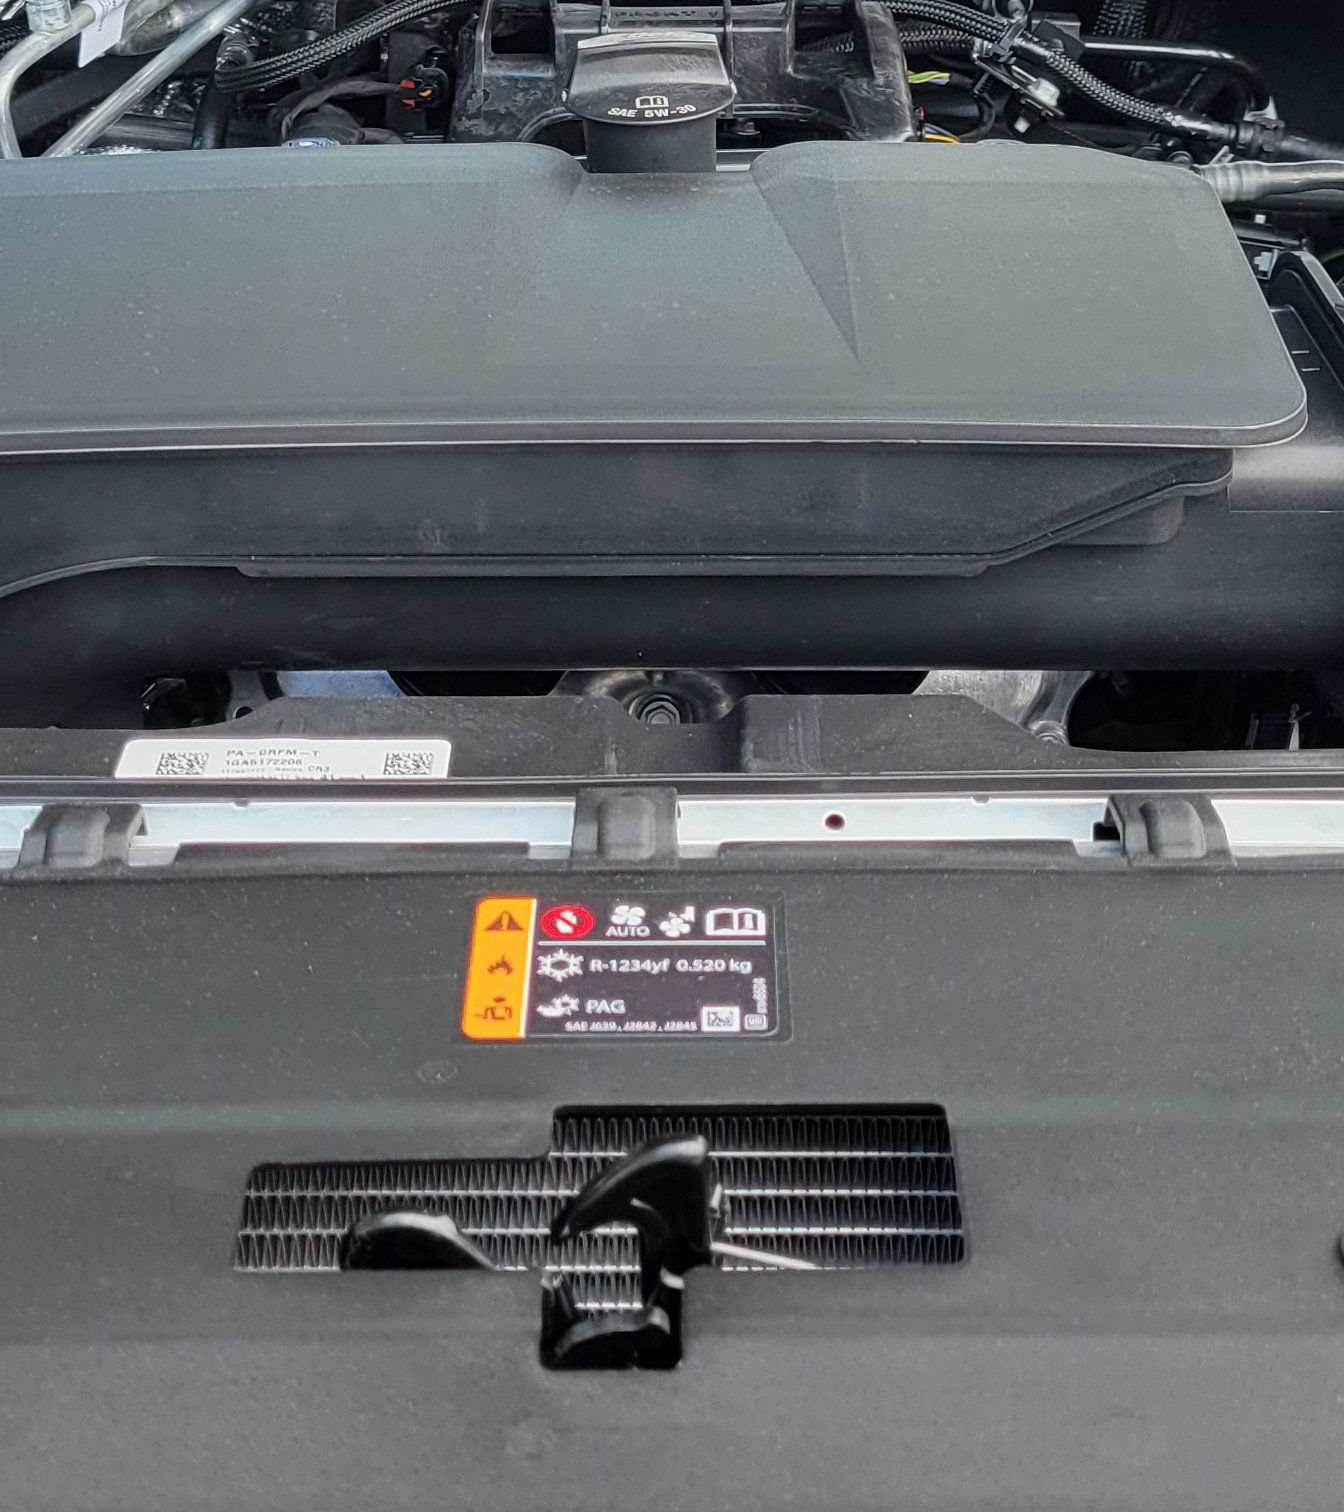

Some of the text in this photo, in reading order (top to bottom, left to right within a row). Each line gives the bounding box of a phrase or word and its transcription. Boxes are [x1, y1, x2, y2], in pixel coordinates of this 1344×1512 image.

[608, 104, 696, 118] SAE 5W-30
[607, 925, 651, 937] AUTO
[589, 959, 752, 975] R-1234yf 0.520 kg
[585, 999, 626, 1014] PAG
[565, 1021, 588, 1032] SAE
